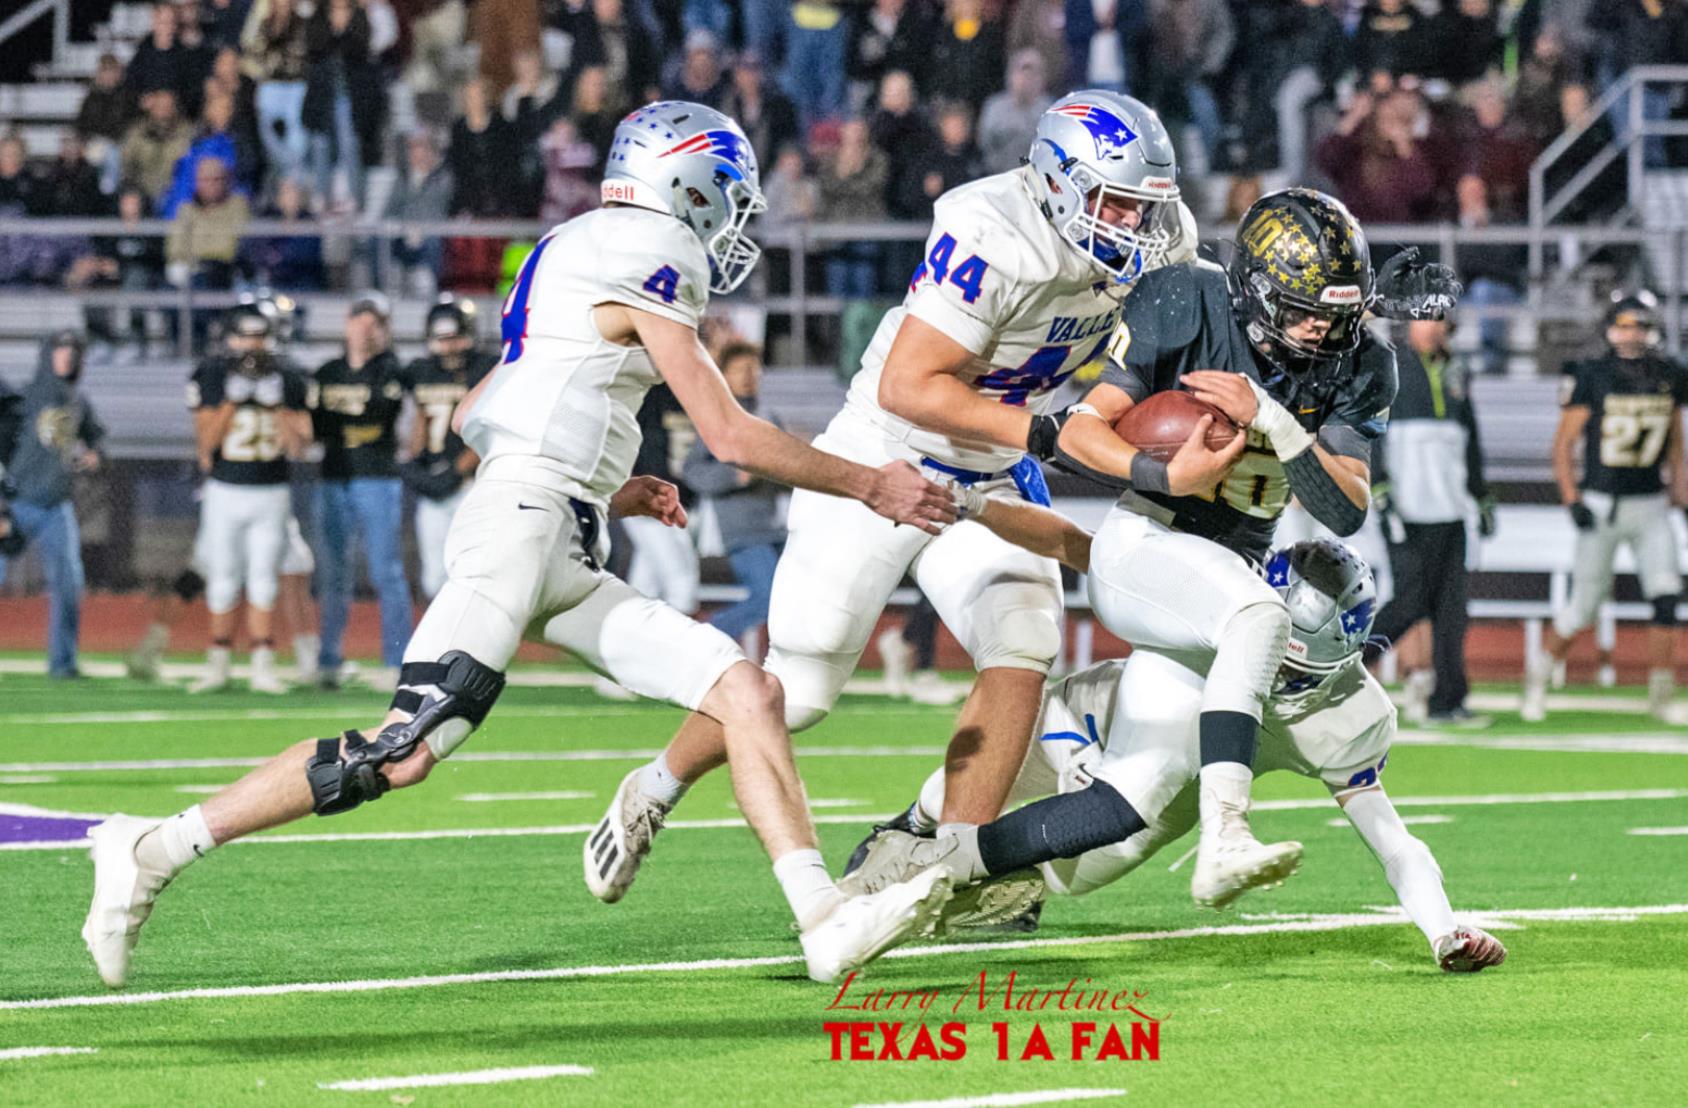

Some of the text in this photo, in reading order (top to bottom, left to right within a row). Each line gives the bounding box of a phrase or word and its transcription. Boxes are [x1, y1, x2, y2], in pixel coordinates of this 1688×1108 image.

[642, 264, 680, 304] 4
[928, 232, 989, 305] 44
[1045, 305, 1120, 343] VALLE
[1601, 414, 1670, 468] 27
